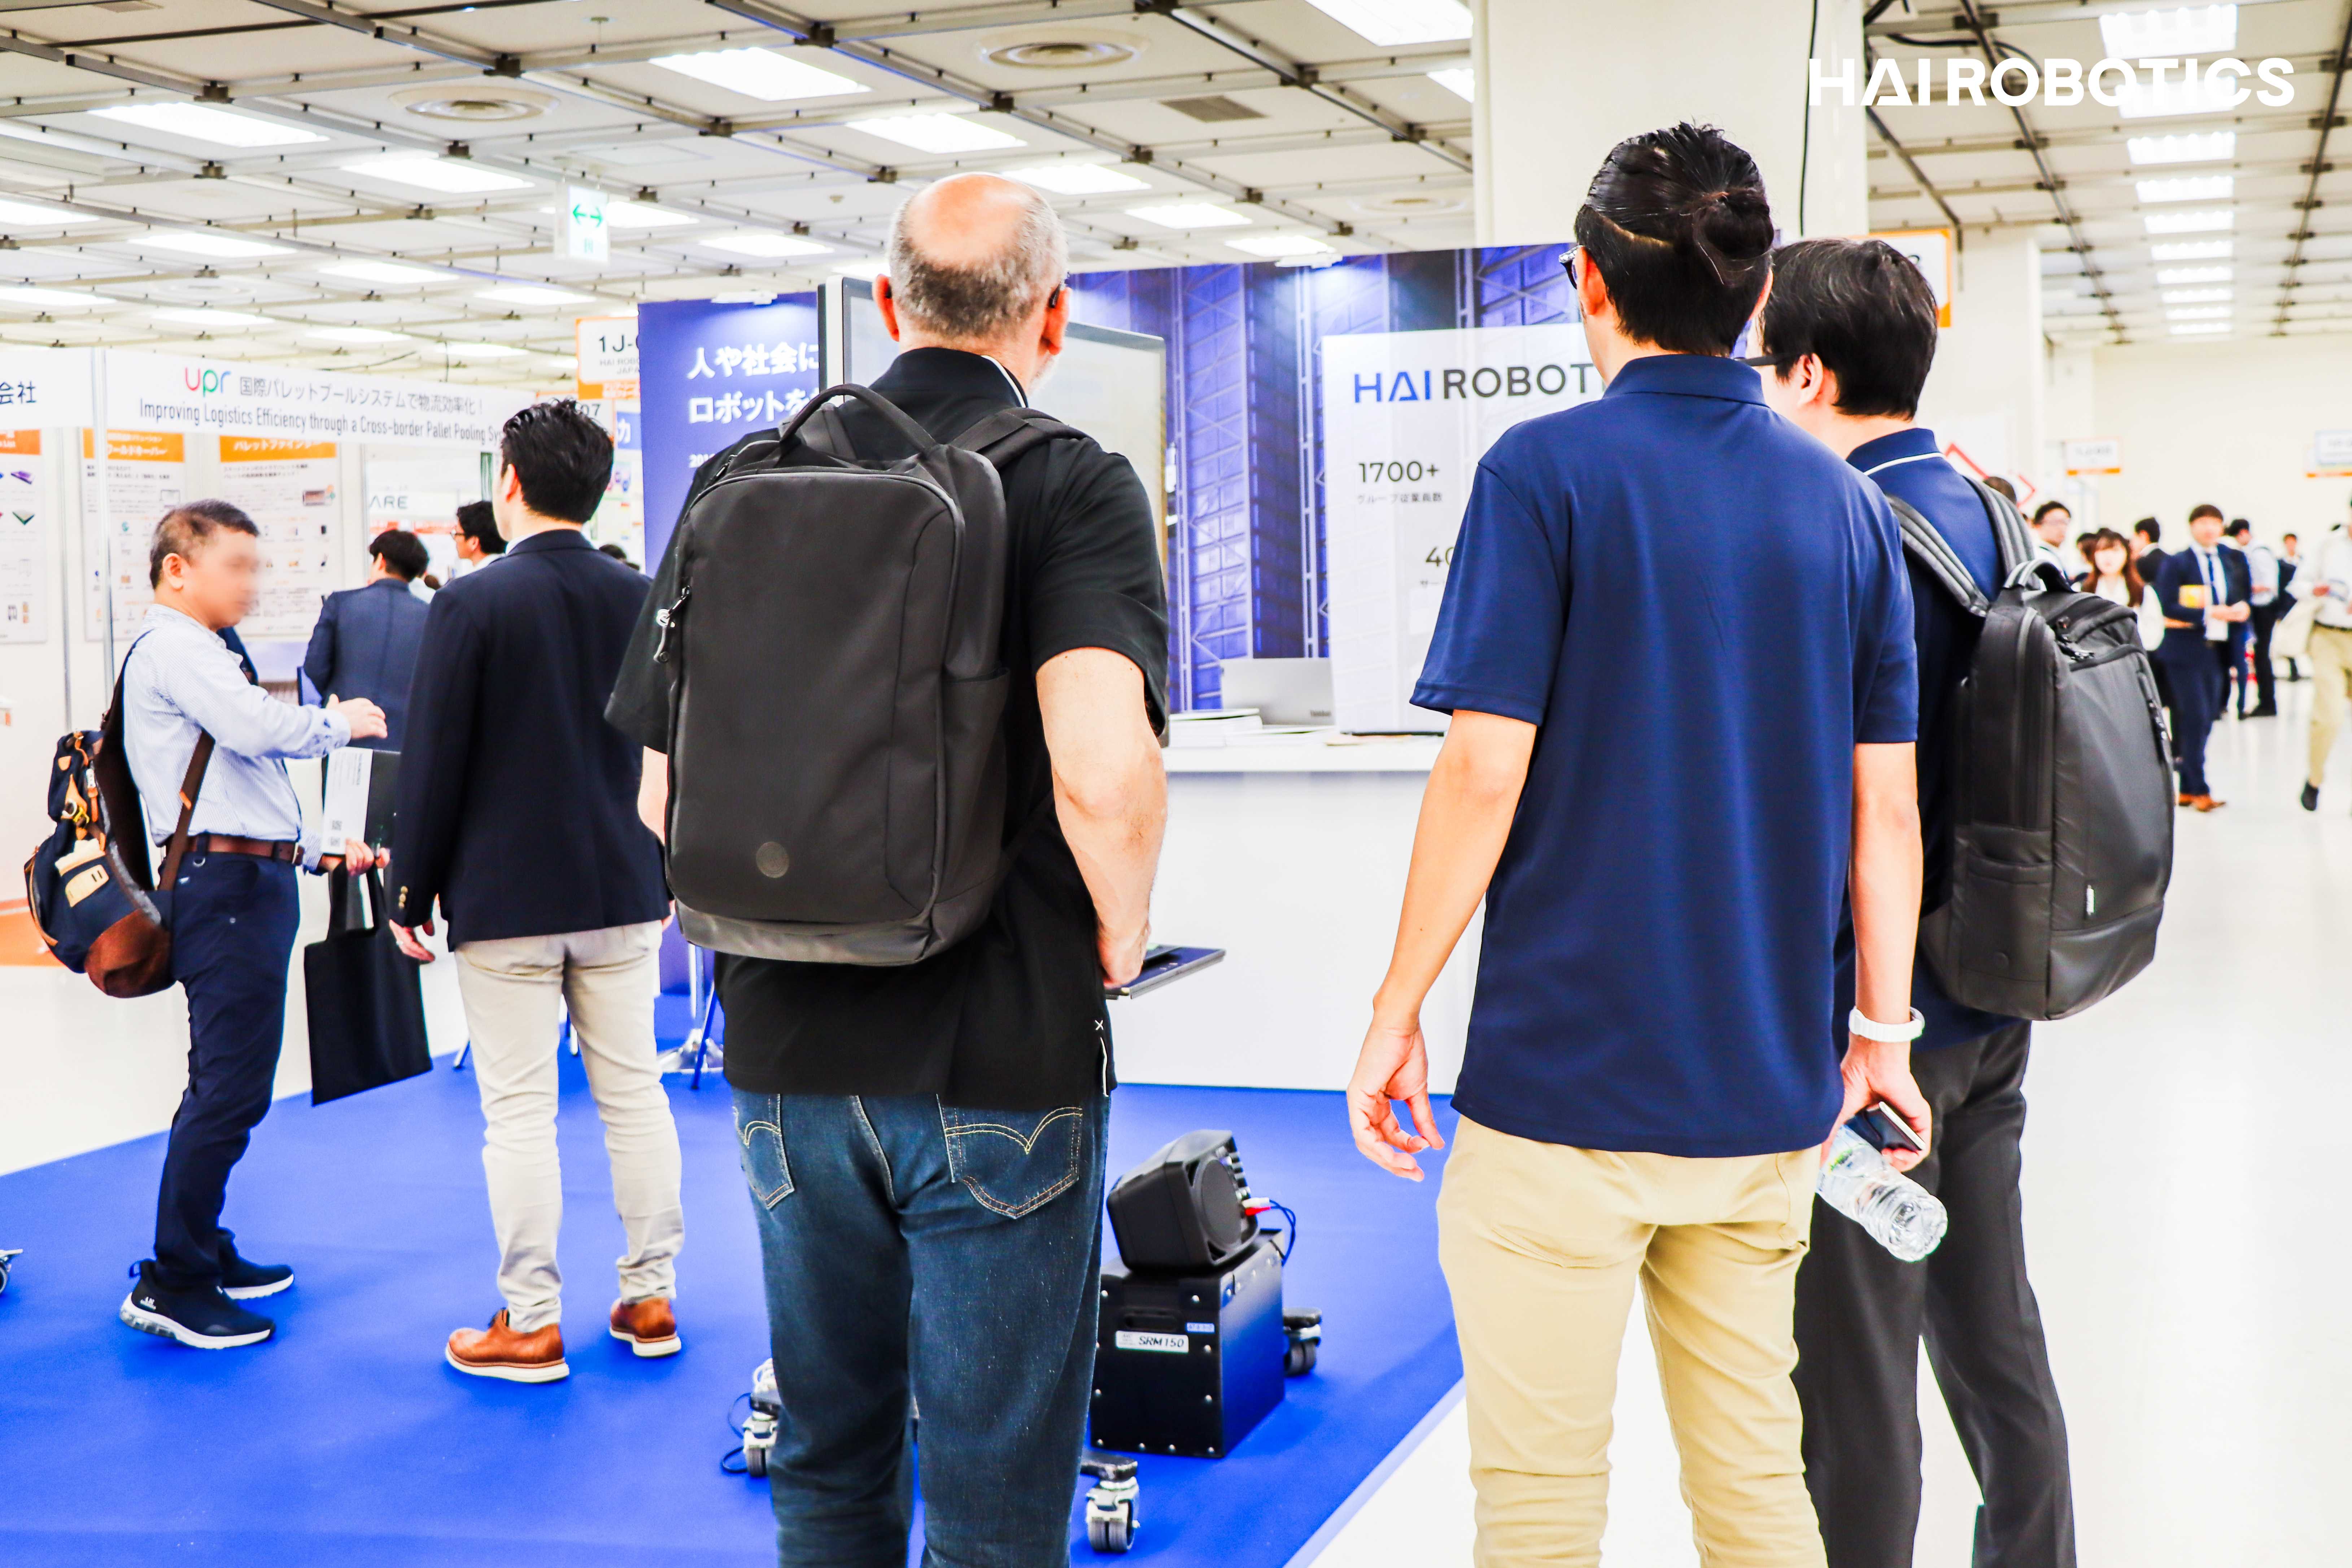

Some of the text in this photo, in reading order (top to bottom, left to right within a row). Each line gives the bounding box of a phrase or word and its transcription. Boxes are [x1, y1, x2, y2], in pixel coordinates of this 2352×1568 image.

[599, 334, 638, 353] 1J-
[687, 342, 819, 379] 人や社会に
[185, 367, 231, 397] upr
[1354, 370, 1431, 403] HAI
[140, 398, 199, 426] Improving
[204, 403, 252, 428] Logistics
[257, 407, 306, 434] Efficiency
[310, 412, 348, 436] through
[352, 420, 357, 432] a
[361, 415, 424, 436] Cross-border
[427, 420, 451, 439] Pallet
[454, 423, 485, 445] Pooling
[1358, 461, 1439, 483] 1700+
[1138, 1336, 1184, 1348] SRM150
